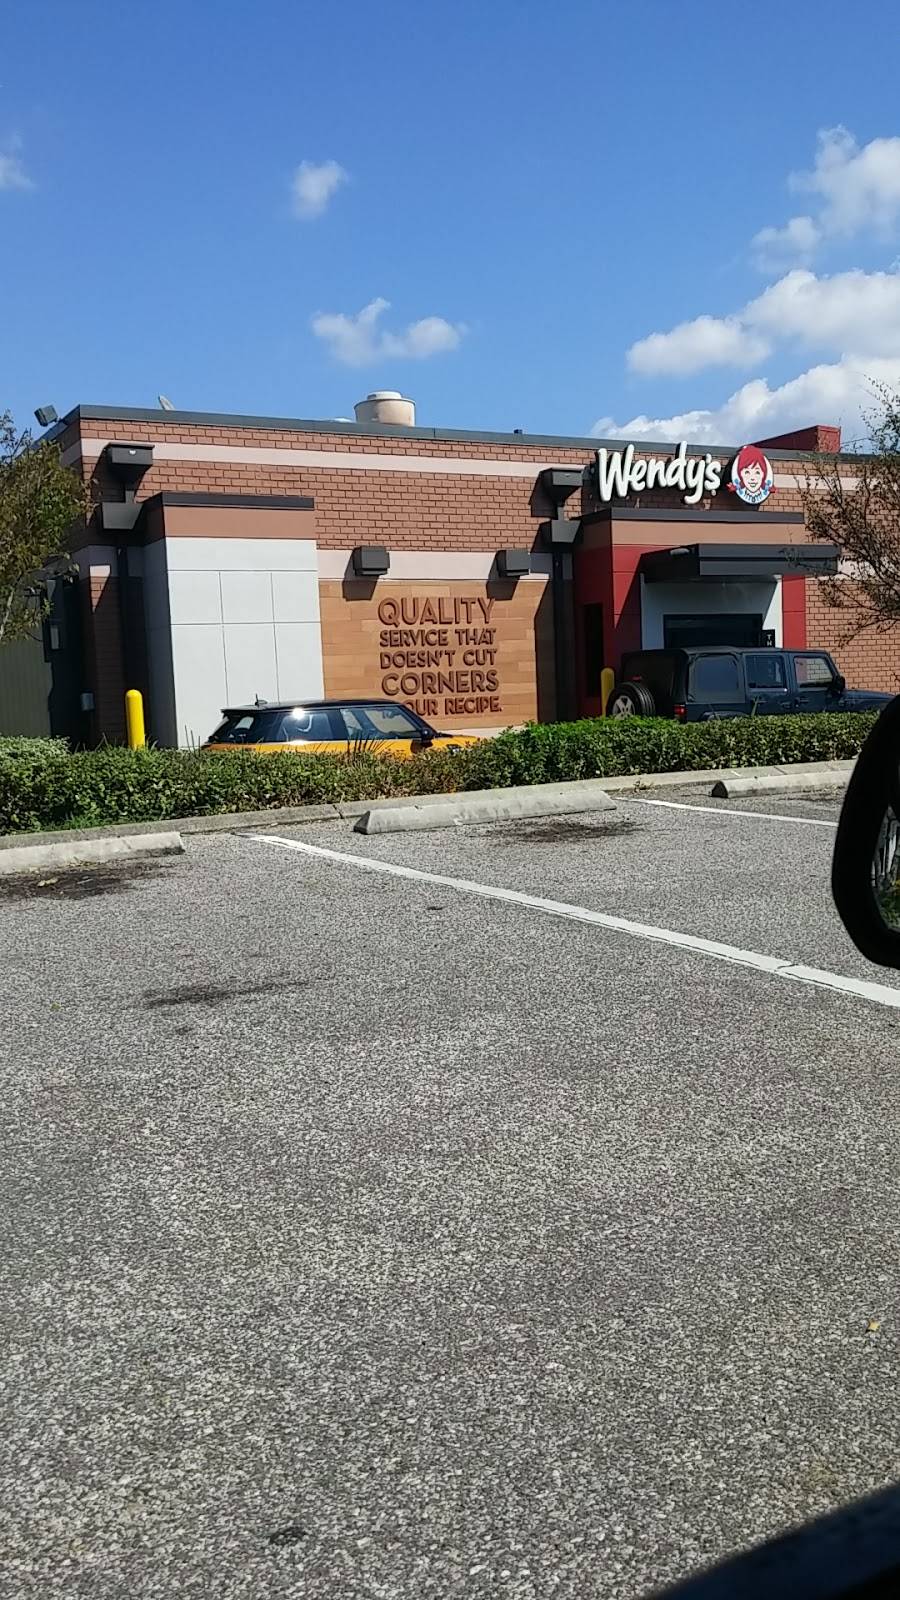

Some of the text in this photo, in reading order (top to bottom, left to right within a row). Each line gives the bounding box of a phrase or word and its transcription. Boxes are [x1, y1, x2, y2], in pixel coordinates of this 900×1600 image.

[597, 441, 721, 504] Wendy's
[378, 597, 495, 627] QUALITY
[379, 628, 496, 647] SERVICE THAT
[380, 649, 497, 669] DOESN'T CUT
[381, 669, 500, 696] CORNERS
[444, 695, 502, 715] RECIPE.
